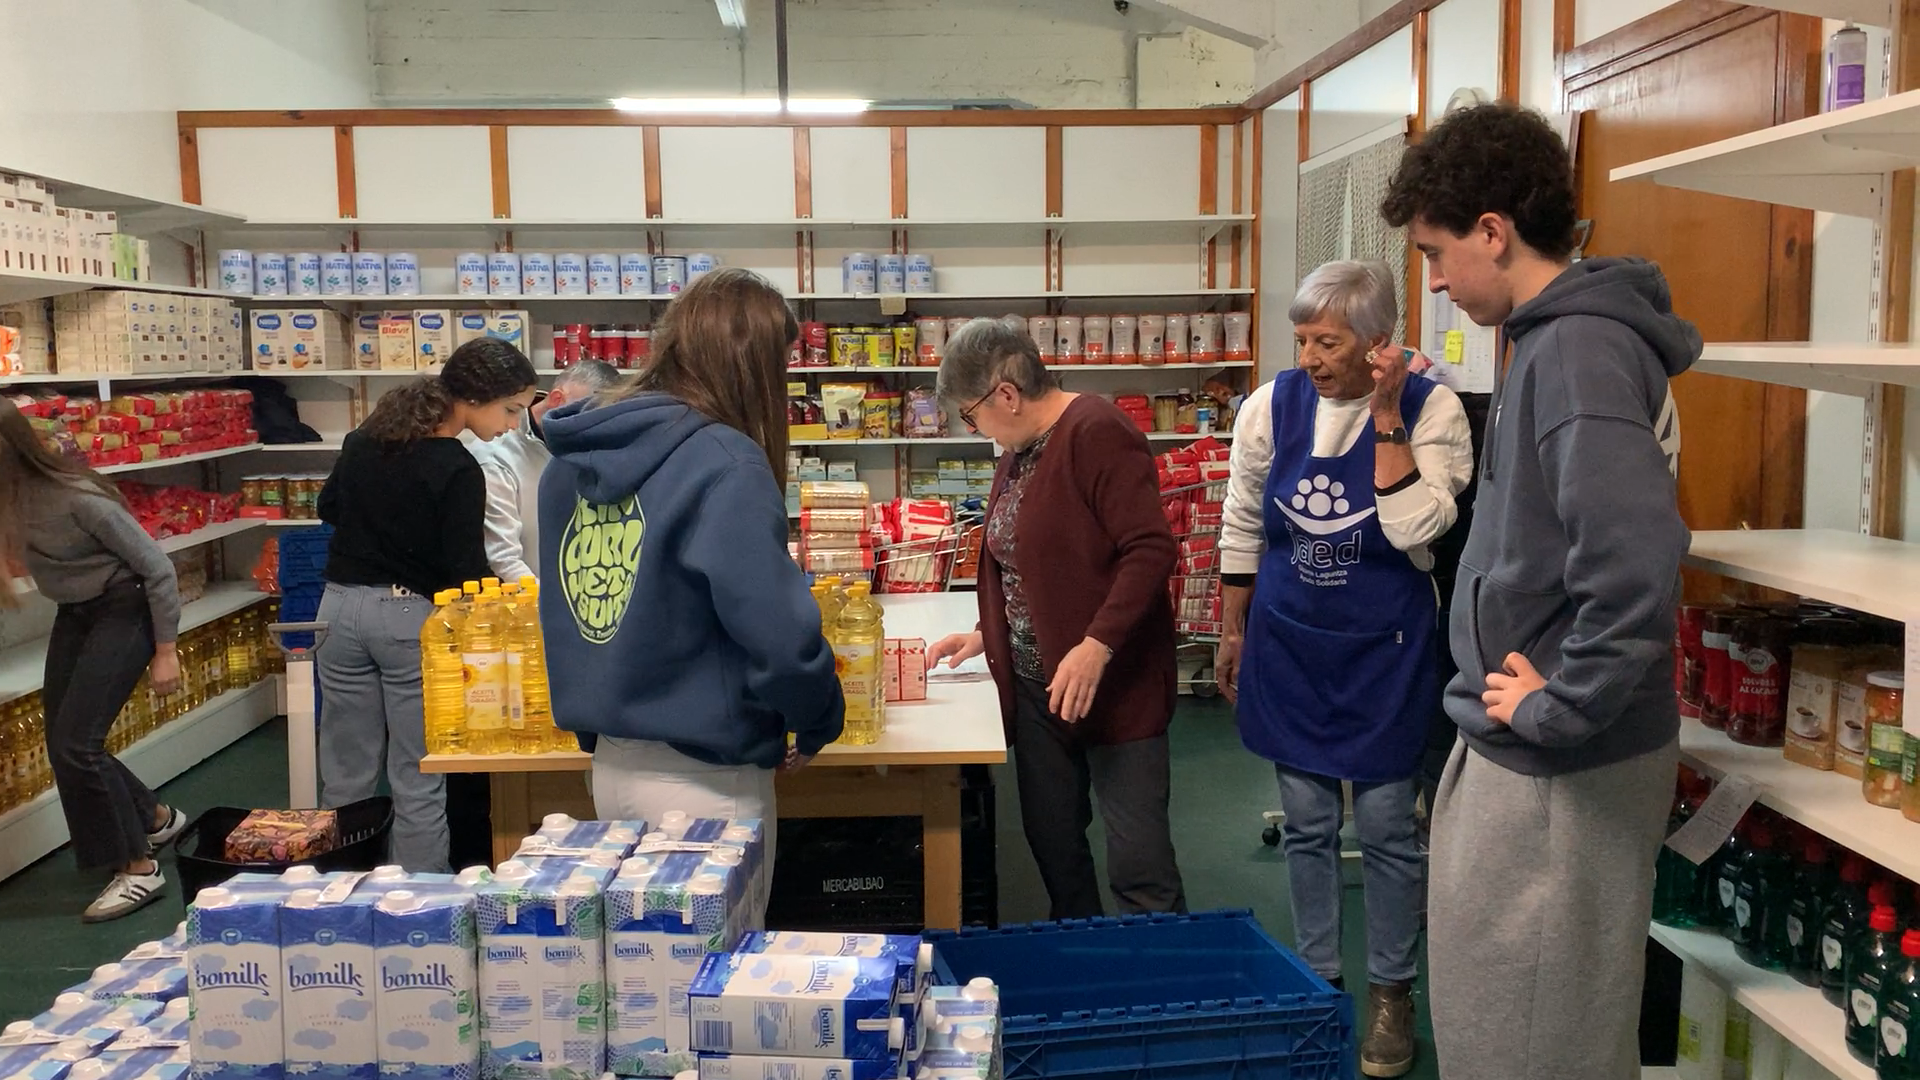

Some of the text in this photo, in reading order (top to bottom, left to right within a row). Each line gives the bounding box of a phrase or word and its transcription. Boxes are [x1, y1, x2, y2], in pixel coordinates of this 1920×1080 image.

[1285, 520, 1362, 568] jaed
[822, 876, 885, 893] MERCABILBAO
[487, 944, 528, 960] bomilk
[614, 942, 654, 957] bomilk
[671, 942, 706, 957] bomil
[197, 961, 271, 987] bomilk
[289, 961, 365, 987] bomilk
[382, 962, 455, 988] bomilk
[808, 959, 837, 995] bomilk
[815, 1006, 835, 1049] bomilk
